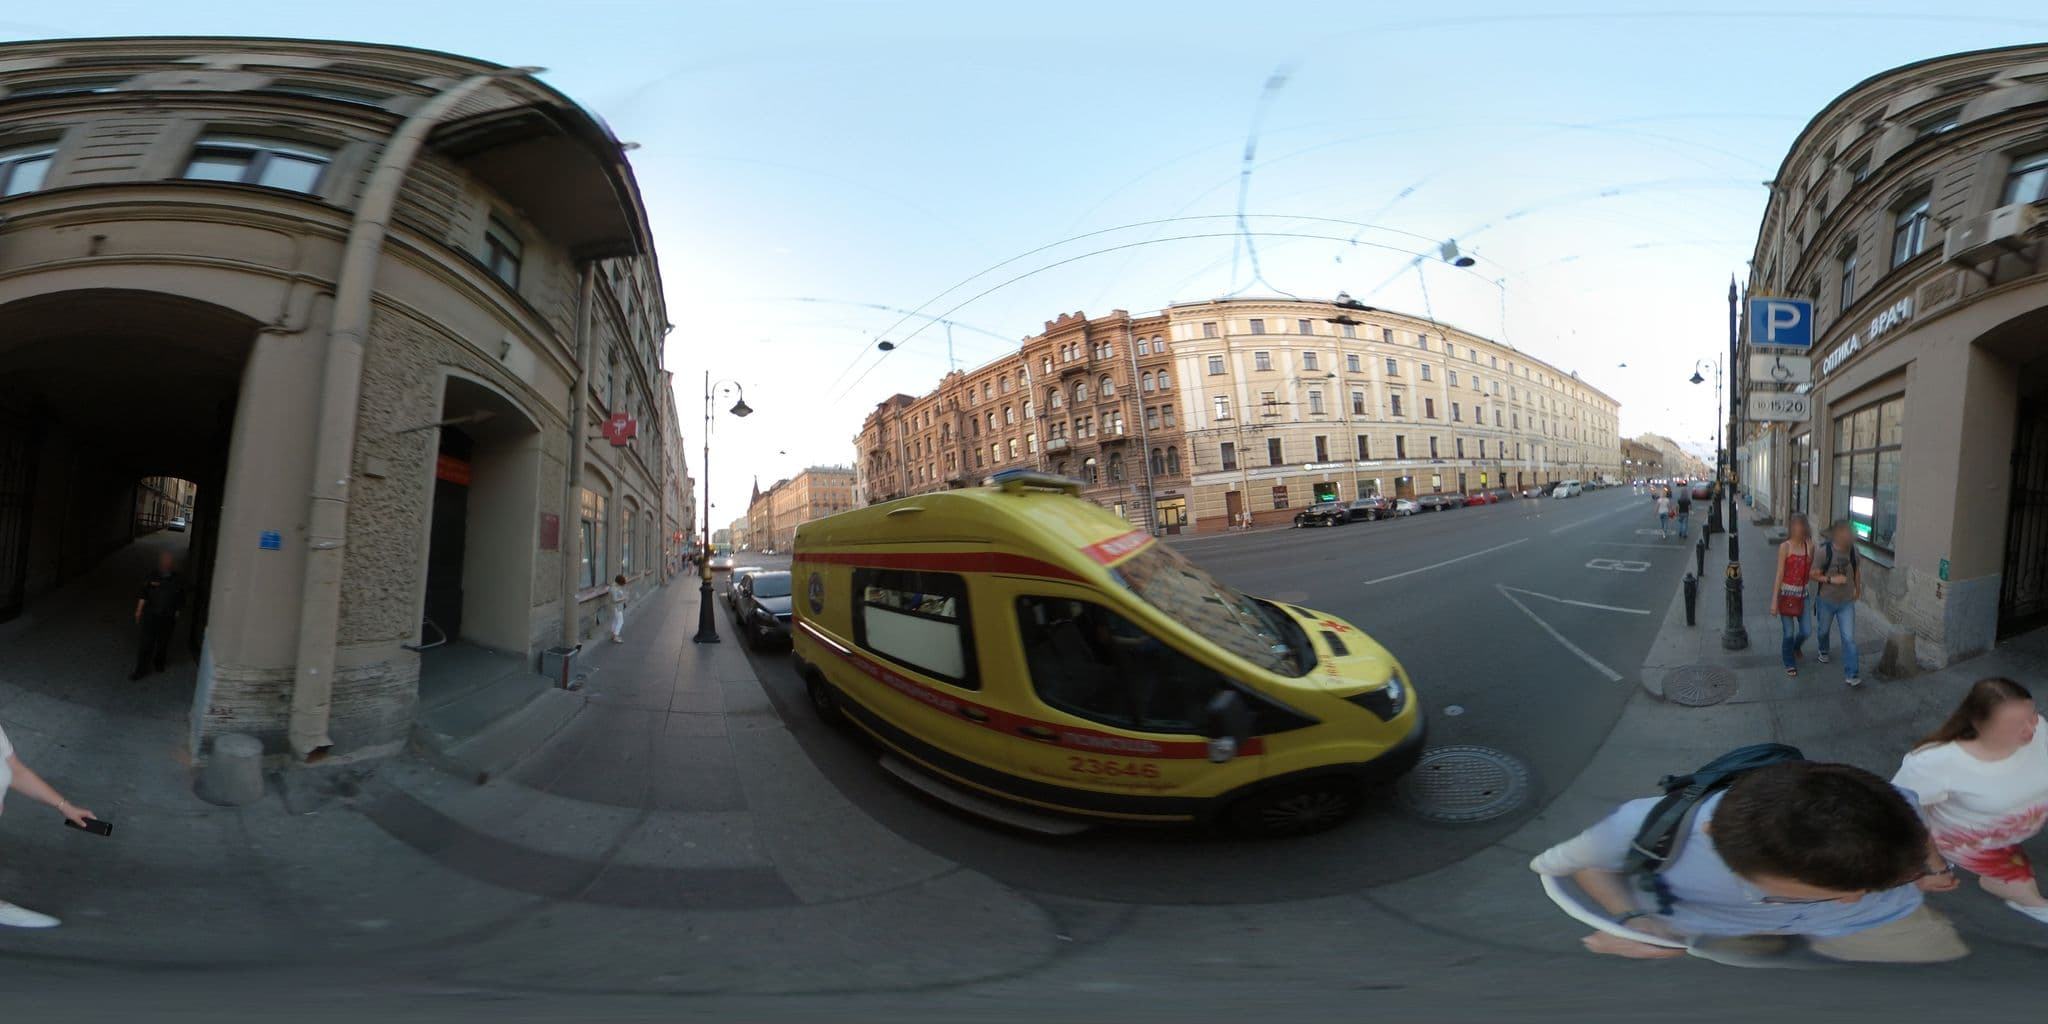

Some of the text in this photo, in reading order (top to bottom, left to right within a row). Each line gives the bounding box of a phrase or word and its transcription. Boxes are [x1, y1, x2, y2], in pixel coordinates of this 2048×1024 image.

[1767, 302, 1801, 342] P
[1822, 295, 1914, 375] ОПТИКА ВРАЧ
[1785, 400, 1804, 413] 20
[1068, 756, 1160, 778] 23646
